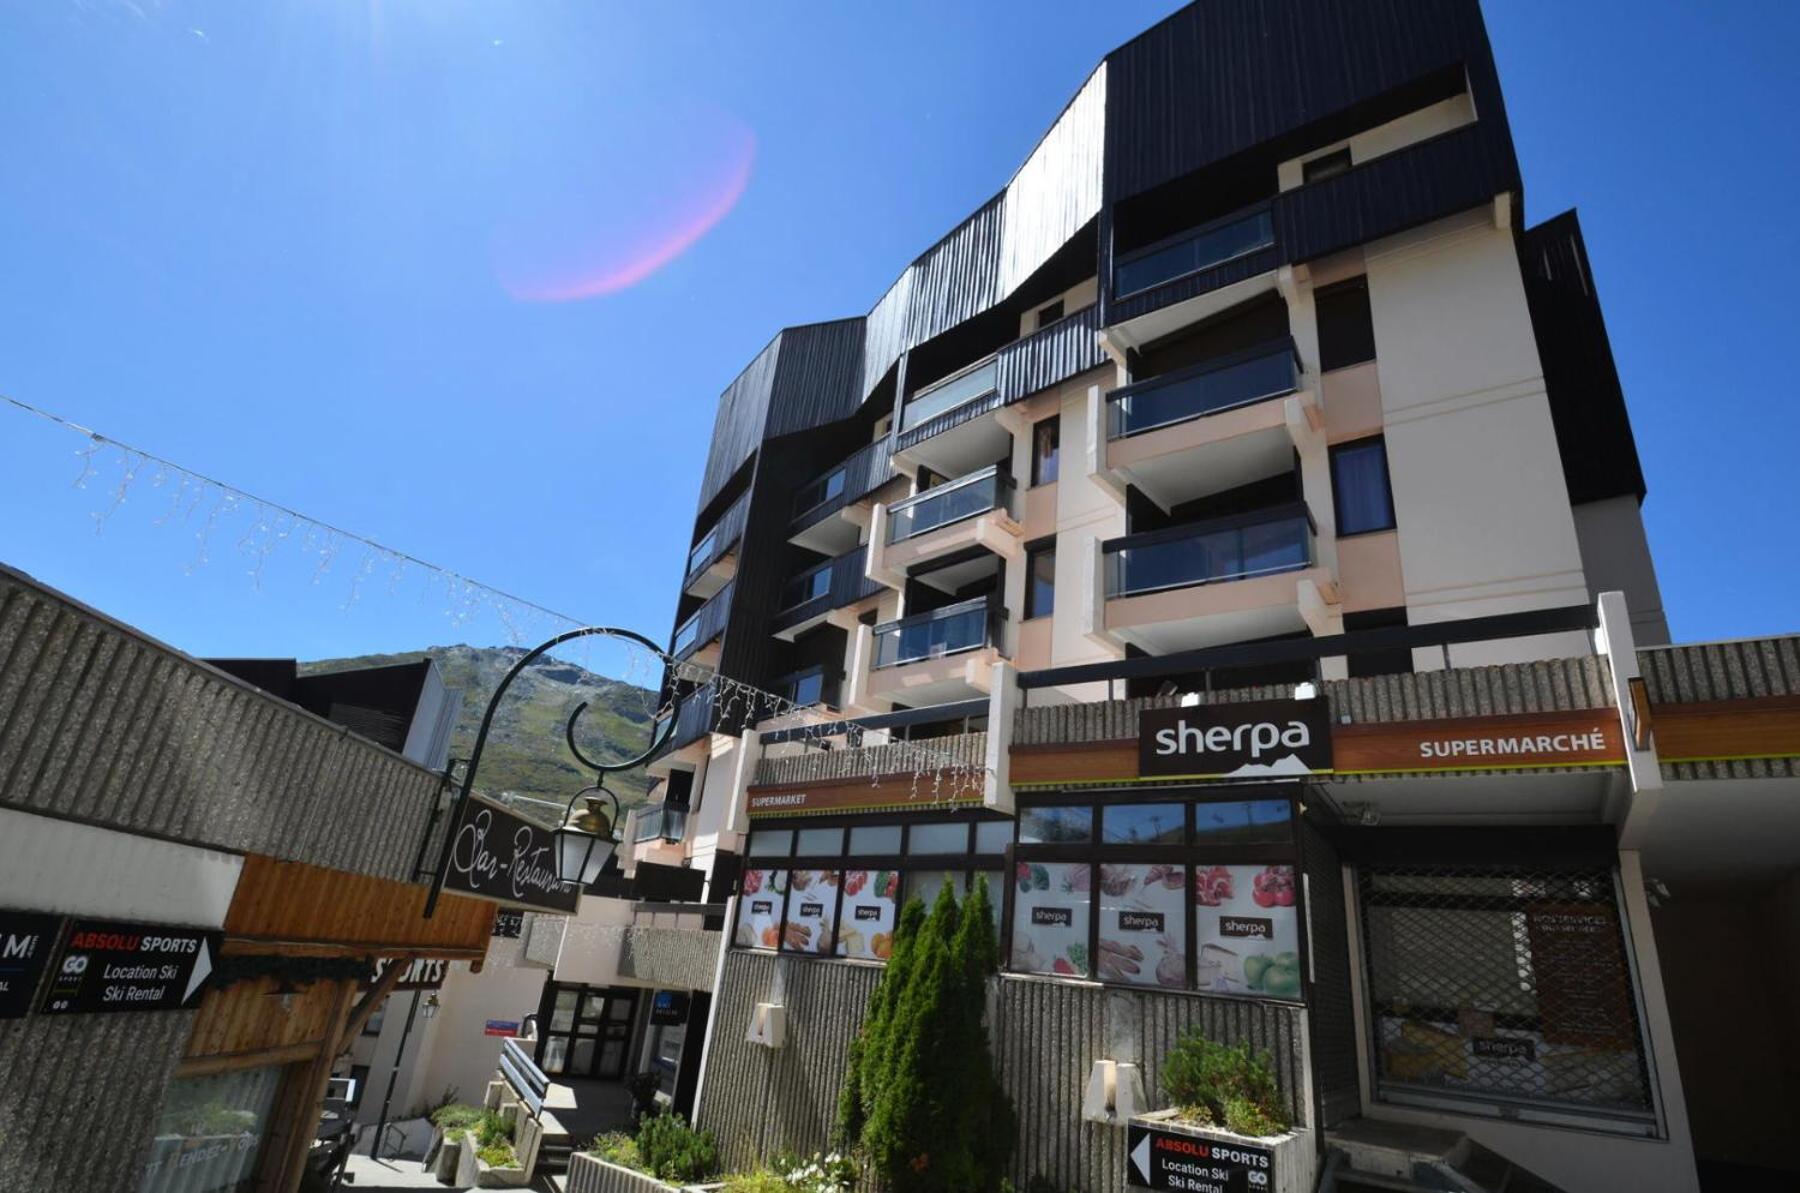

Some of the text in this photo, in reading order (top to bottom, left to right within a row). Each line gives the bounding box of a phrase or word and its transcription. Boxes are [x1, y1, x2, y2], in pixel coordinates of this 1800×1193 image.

[1155, 720, 1310, 758] sherpa
[1420, 727, 1606, 759] SUPERMARCHÉ
[752, 794, 807, 807] SUPERMARKET
[1035, 910, 1067, 923] sherpa
[1123, 917, 1159, 930] sherpa
[1225, 920, 1266, 935] sherpa
[71, 932, 197, 953] ABSOLU SPORTS
[62, 955, 88, 974] GO
[103, 963, 178, 979] Location Ski
[371, 958, 444, 983] SORTS
[103, 985, 165, 1001] Ski Rental
[1156, 1137, 1269, 1168] ABSOLU SPORTS
[1162, 1158, 1229, 1181] Location Ski
[1248, 1170, 1267, 1184] GO
[1168, 1175, 1223, 1193] Ski Rental
